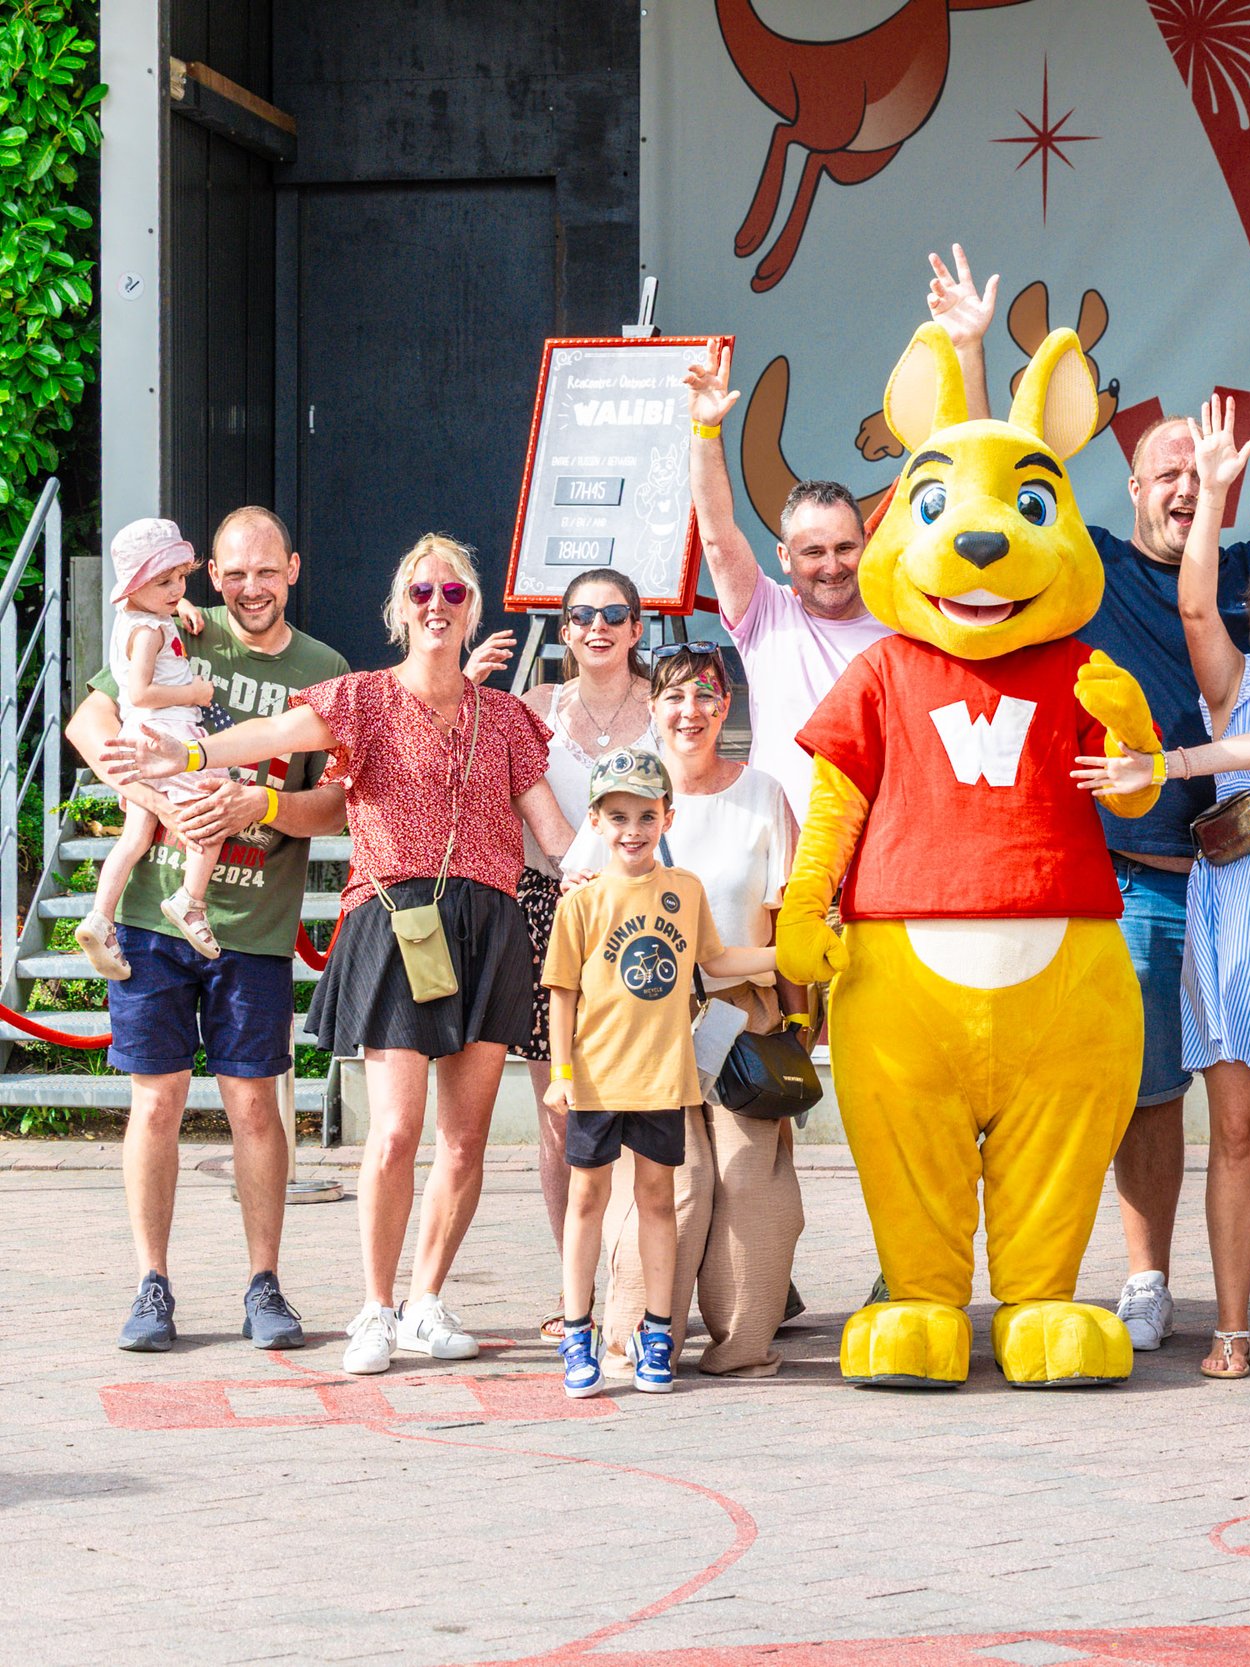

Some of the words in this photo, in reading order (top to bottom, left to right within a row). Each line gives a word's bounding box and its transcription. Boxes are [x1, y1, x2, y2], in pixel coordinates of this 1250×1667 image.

[569, 481, 608, 500] 17H45
[558, 541, 600, 559] 18H00
[190, 656, 301, 717] D-DA
[928, 694, 1038, 787] W
[211, 864, 265, 888] 2024
[603, 915, 647, 964] SUNNY
[654, 915, 687, 953] DAYS
